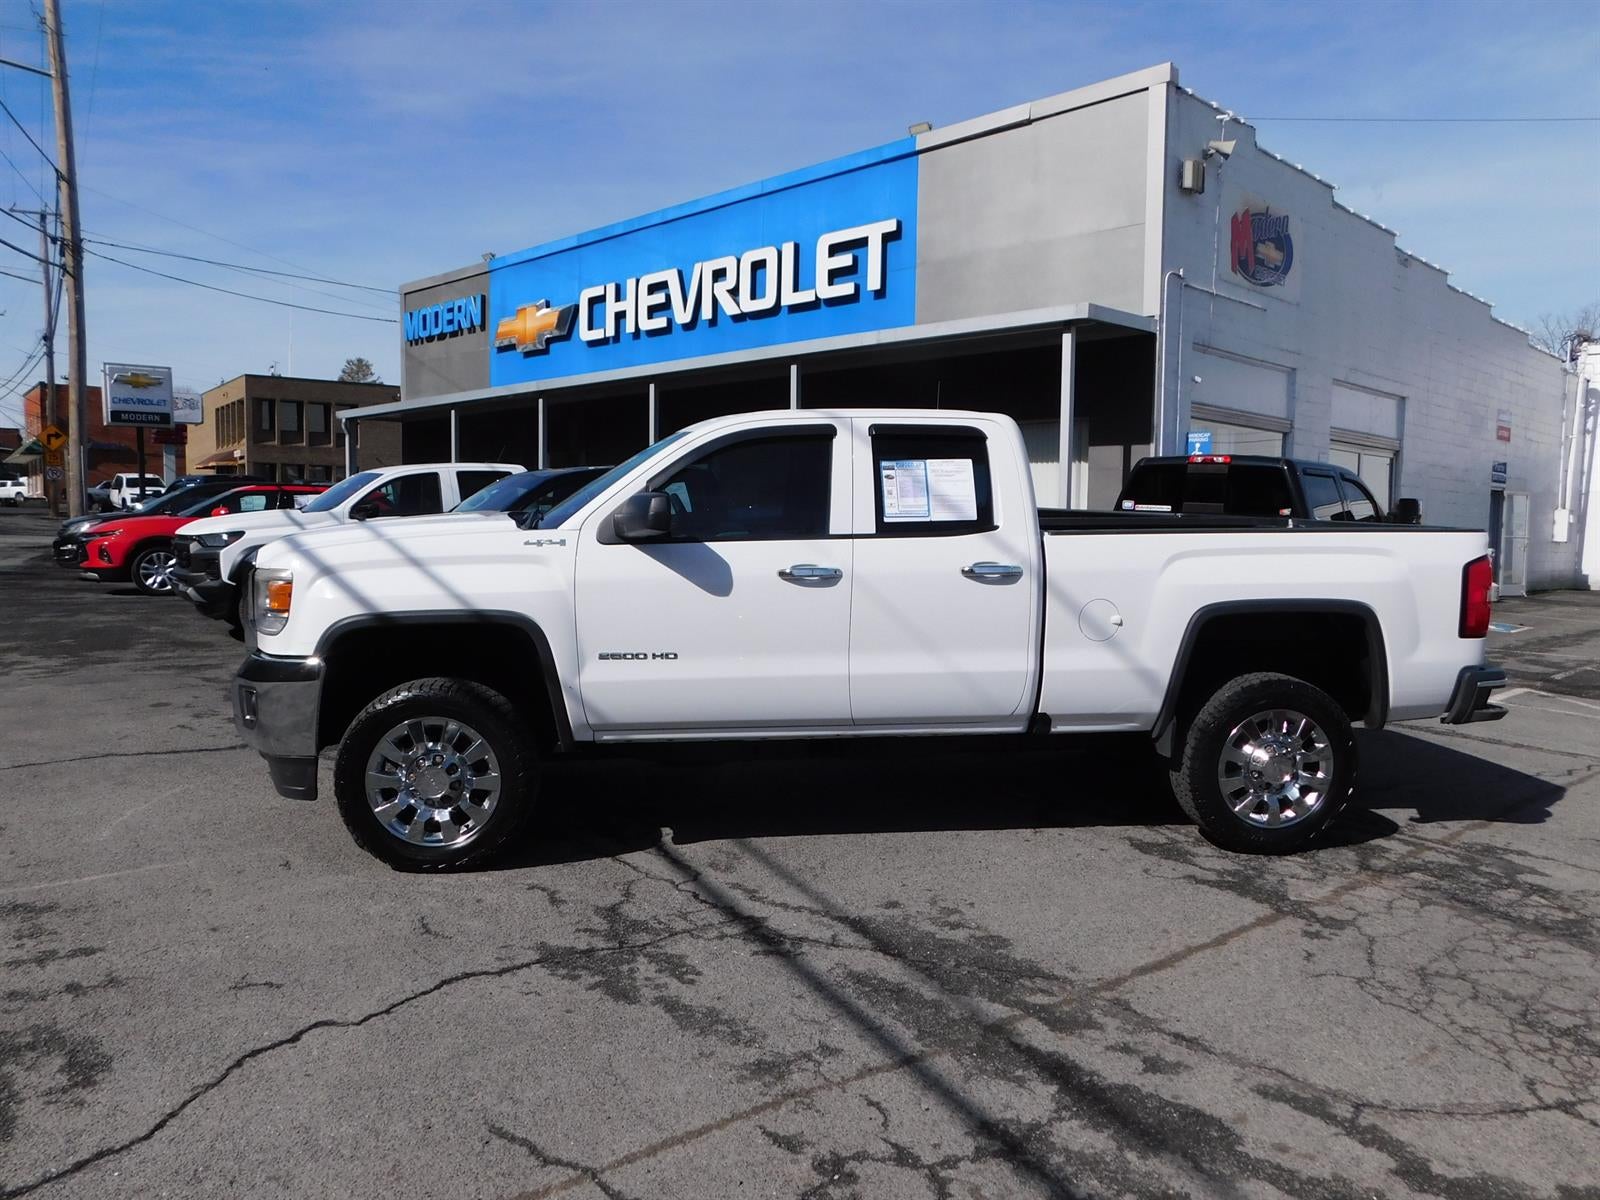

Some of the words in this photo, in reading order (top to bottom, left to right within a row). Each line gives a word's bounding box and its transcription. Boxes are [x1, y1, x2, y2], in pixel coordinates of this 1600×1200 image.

[578, 218, 898, 343] CHEVROLET
[404, 294, 483, 342] MODERN
[112, 396, 168, 407] CHEVROLET
[120, 413, 161, 421] MODERN
[598, 652, 648, 660] 2500
[652, 652, 678, 660] HD
